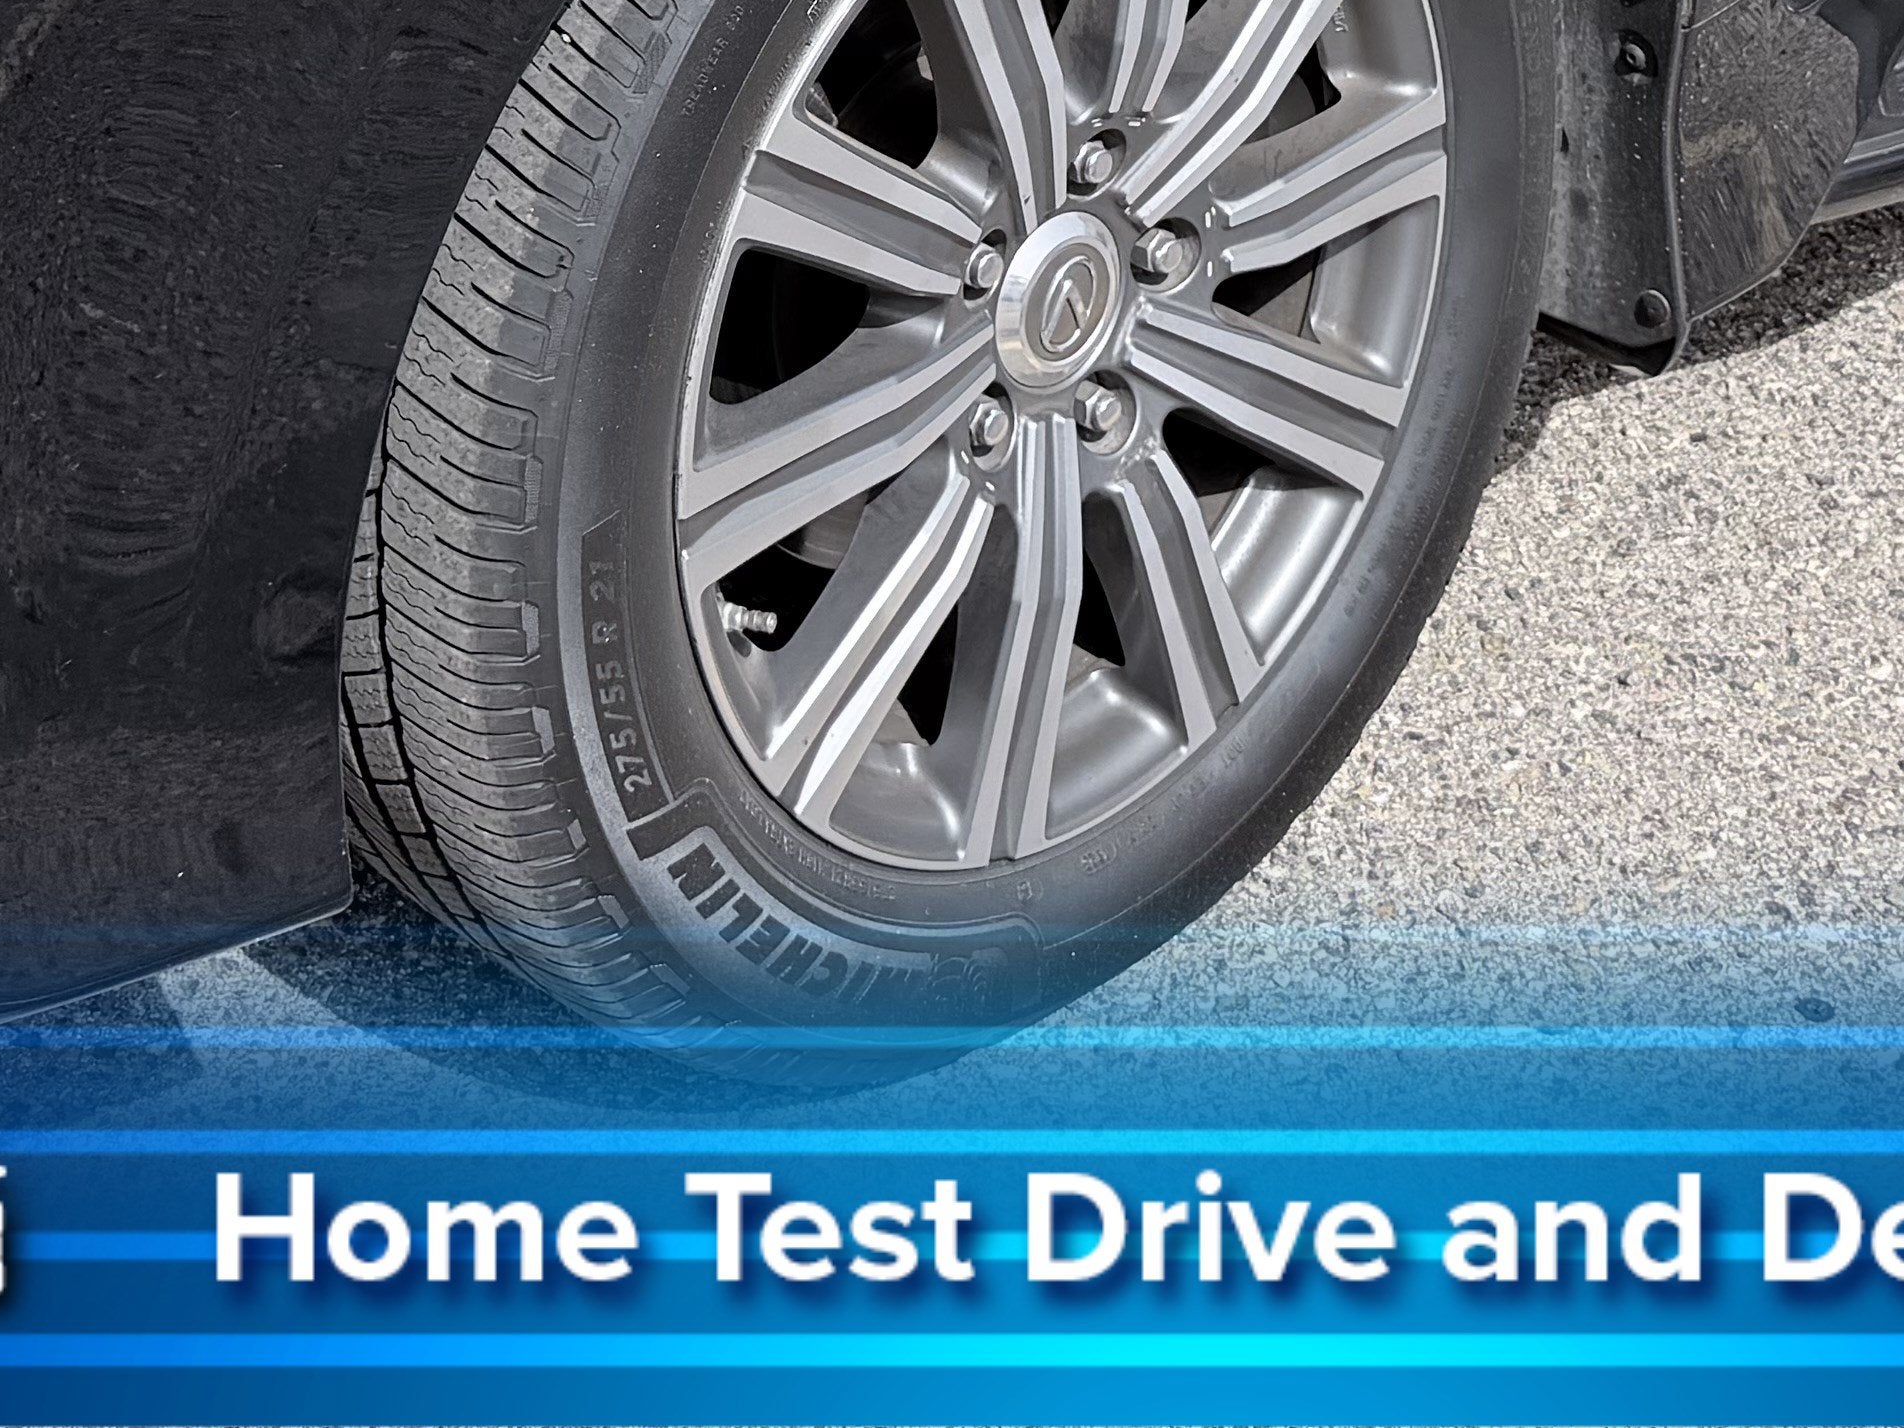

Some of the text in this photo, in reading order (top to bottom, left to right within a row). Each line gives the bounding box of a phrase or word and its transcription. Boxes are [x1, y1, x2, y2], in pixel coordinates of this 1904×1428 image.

[592, 620, 618, 644] R
[596, 659, 653, 793] 275/55
[665, 840, 928, 1009] MICHELIN
